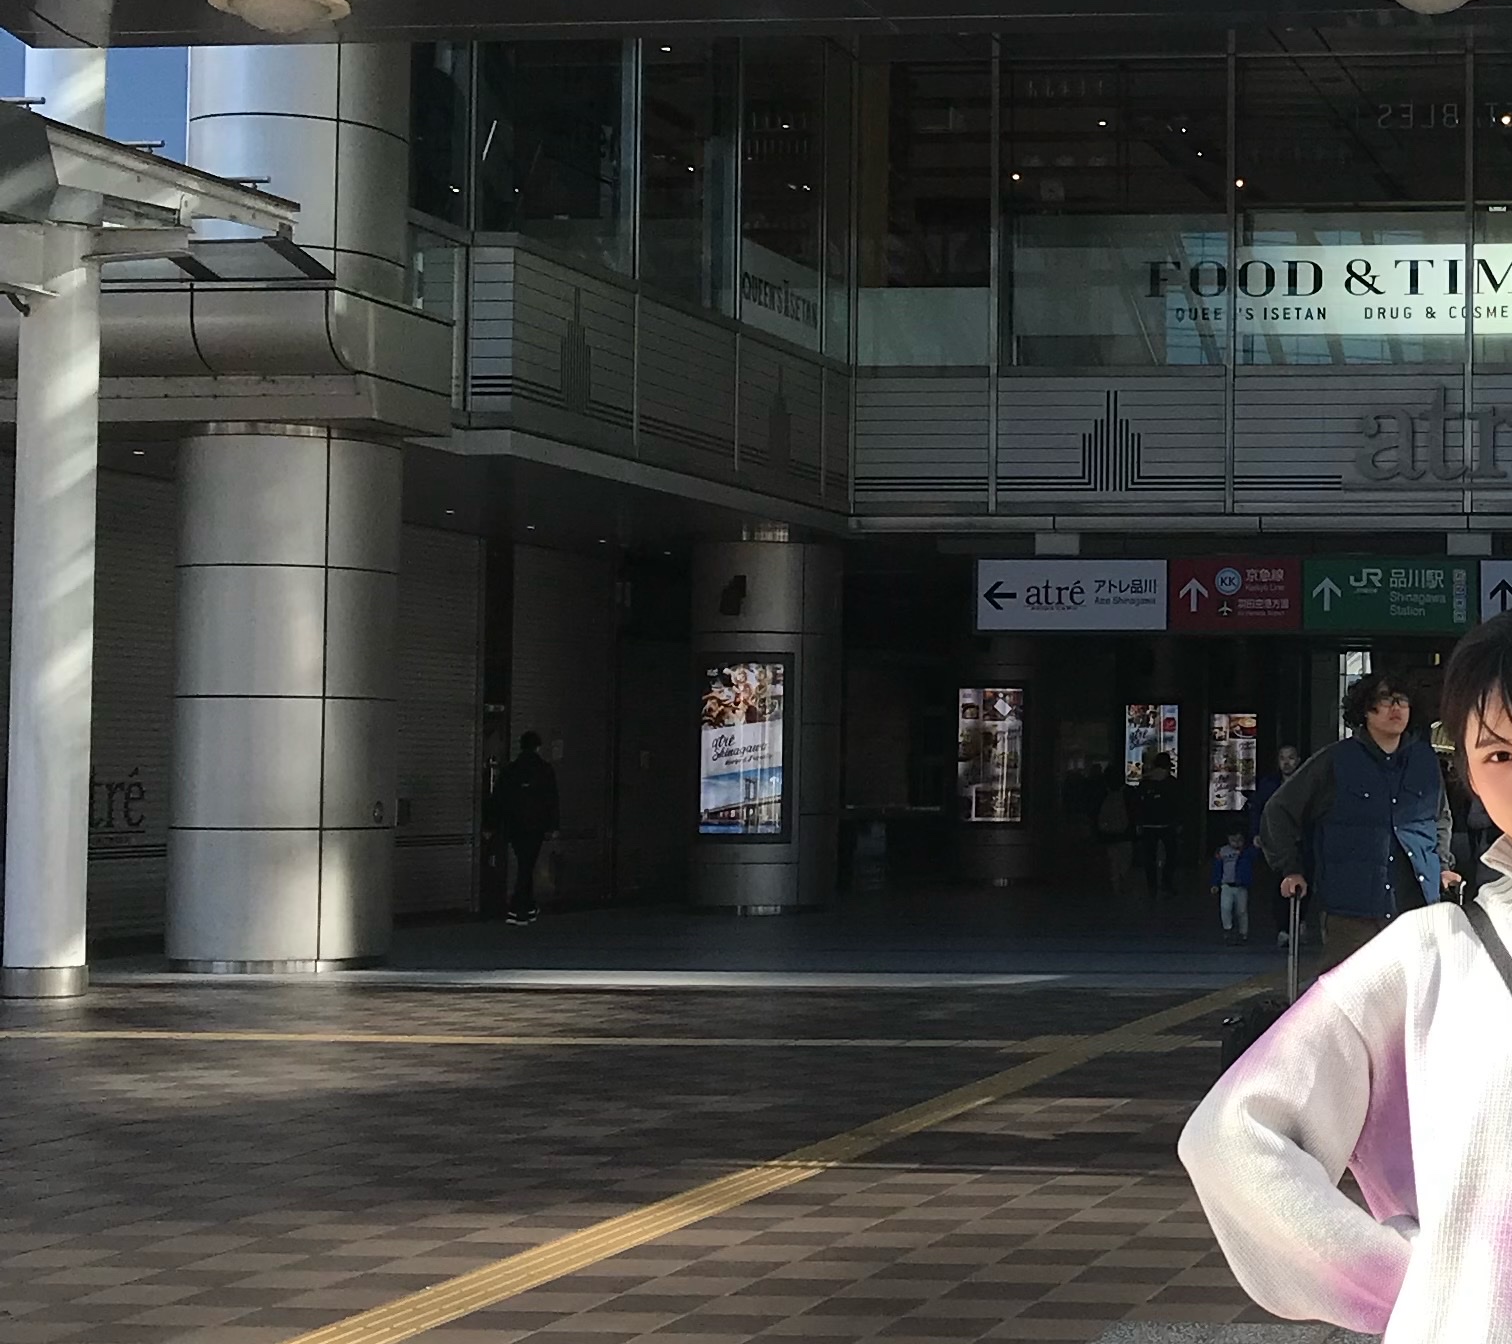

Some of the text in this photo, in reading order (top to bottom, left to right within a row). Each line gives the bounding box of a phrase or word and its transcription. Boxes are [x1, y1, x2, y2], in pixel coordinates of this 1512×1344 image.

[1143, 259, 1323, 298] FOOD
[1344, 258, 1386, 296] &
[1175, 306, 1326, 323] QUEE'S ISETAN
[1364, 306, 1412, 320] DRUG
[1425, 306, 1436, 319] &
[1220, 576, 1237, 587] KK
[1349, 568, 1383, 587] JR
[1389, 568, 1445, 589] 品川駅
[1024, 579, 1085, 605] atré
[1094, 579, 1157, 594] アトレ品川
[1390, 590, 1447, 606] Shinagawa
[1390, 604, 1426, 616] Station
